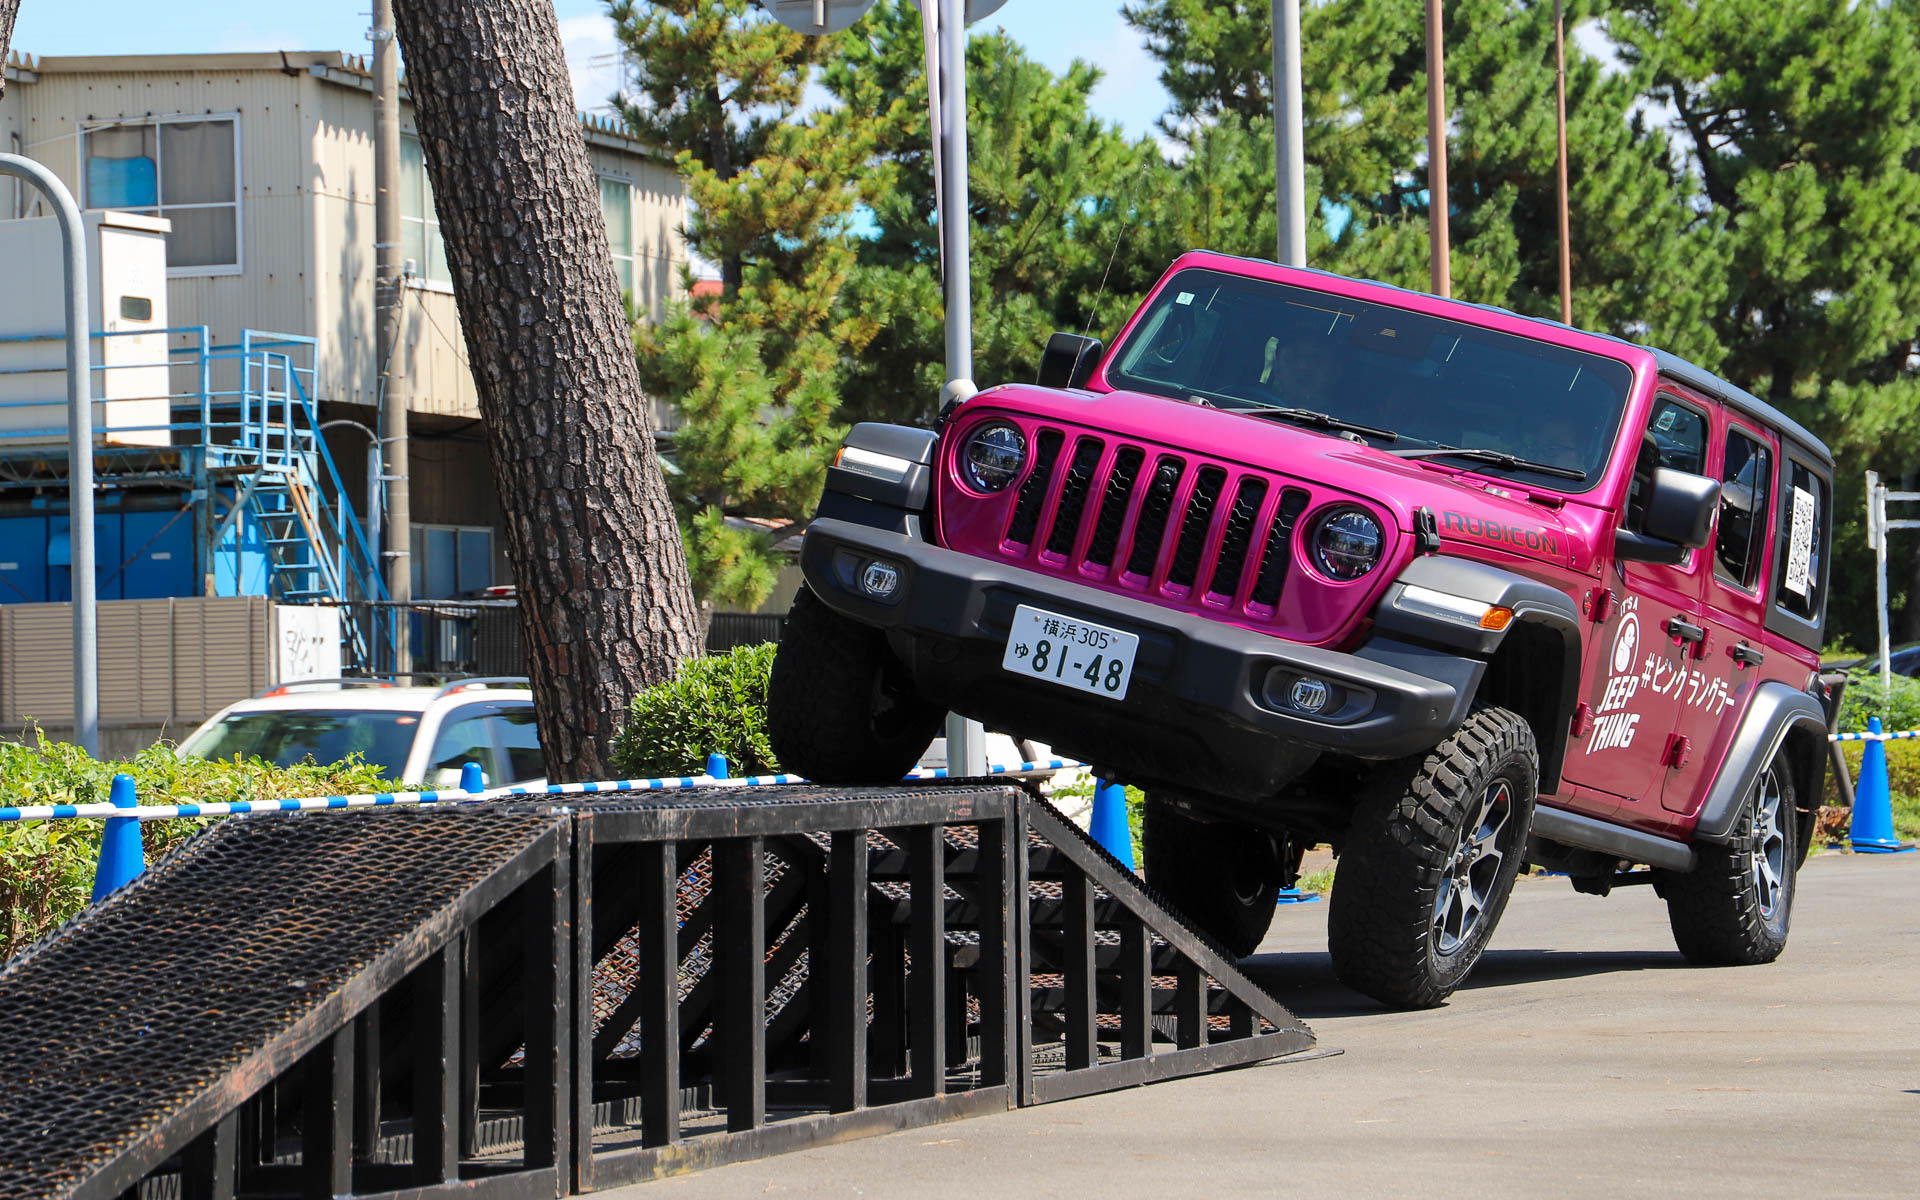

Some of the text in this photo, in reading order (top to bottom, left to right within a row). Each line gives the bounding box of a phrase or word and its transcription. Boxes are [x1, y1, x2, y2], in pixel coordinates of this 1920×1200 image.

[1443, 511, 1557, 555] RUBICON
[1620, 595, 1639, 617] IT'S A
[1014, 639, 1124, 692] ゆ 81-48
[1596, 675, 1640, 714] JEEP
[1585, 712, 1641, 755] THING
